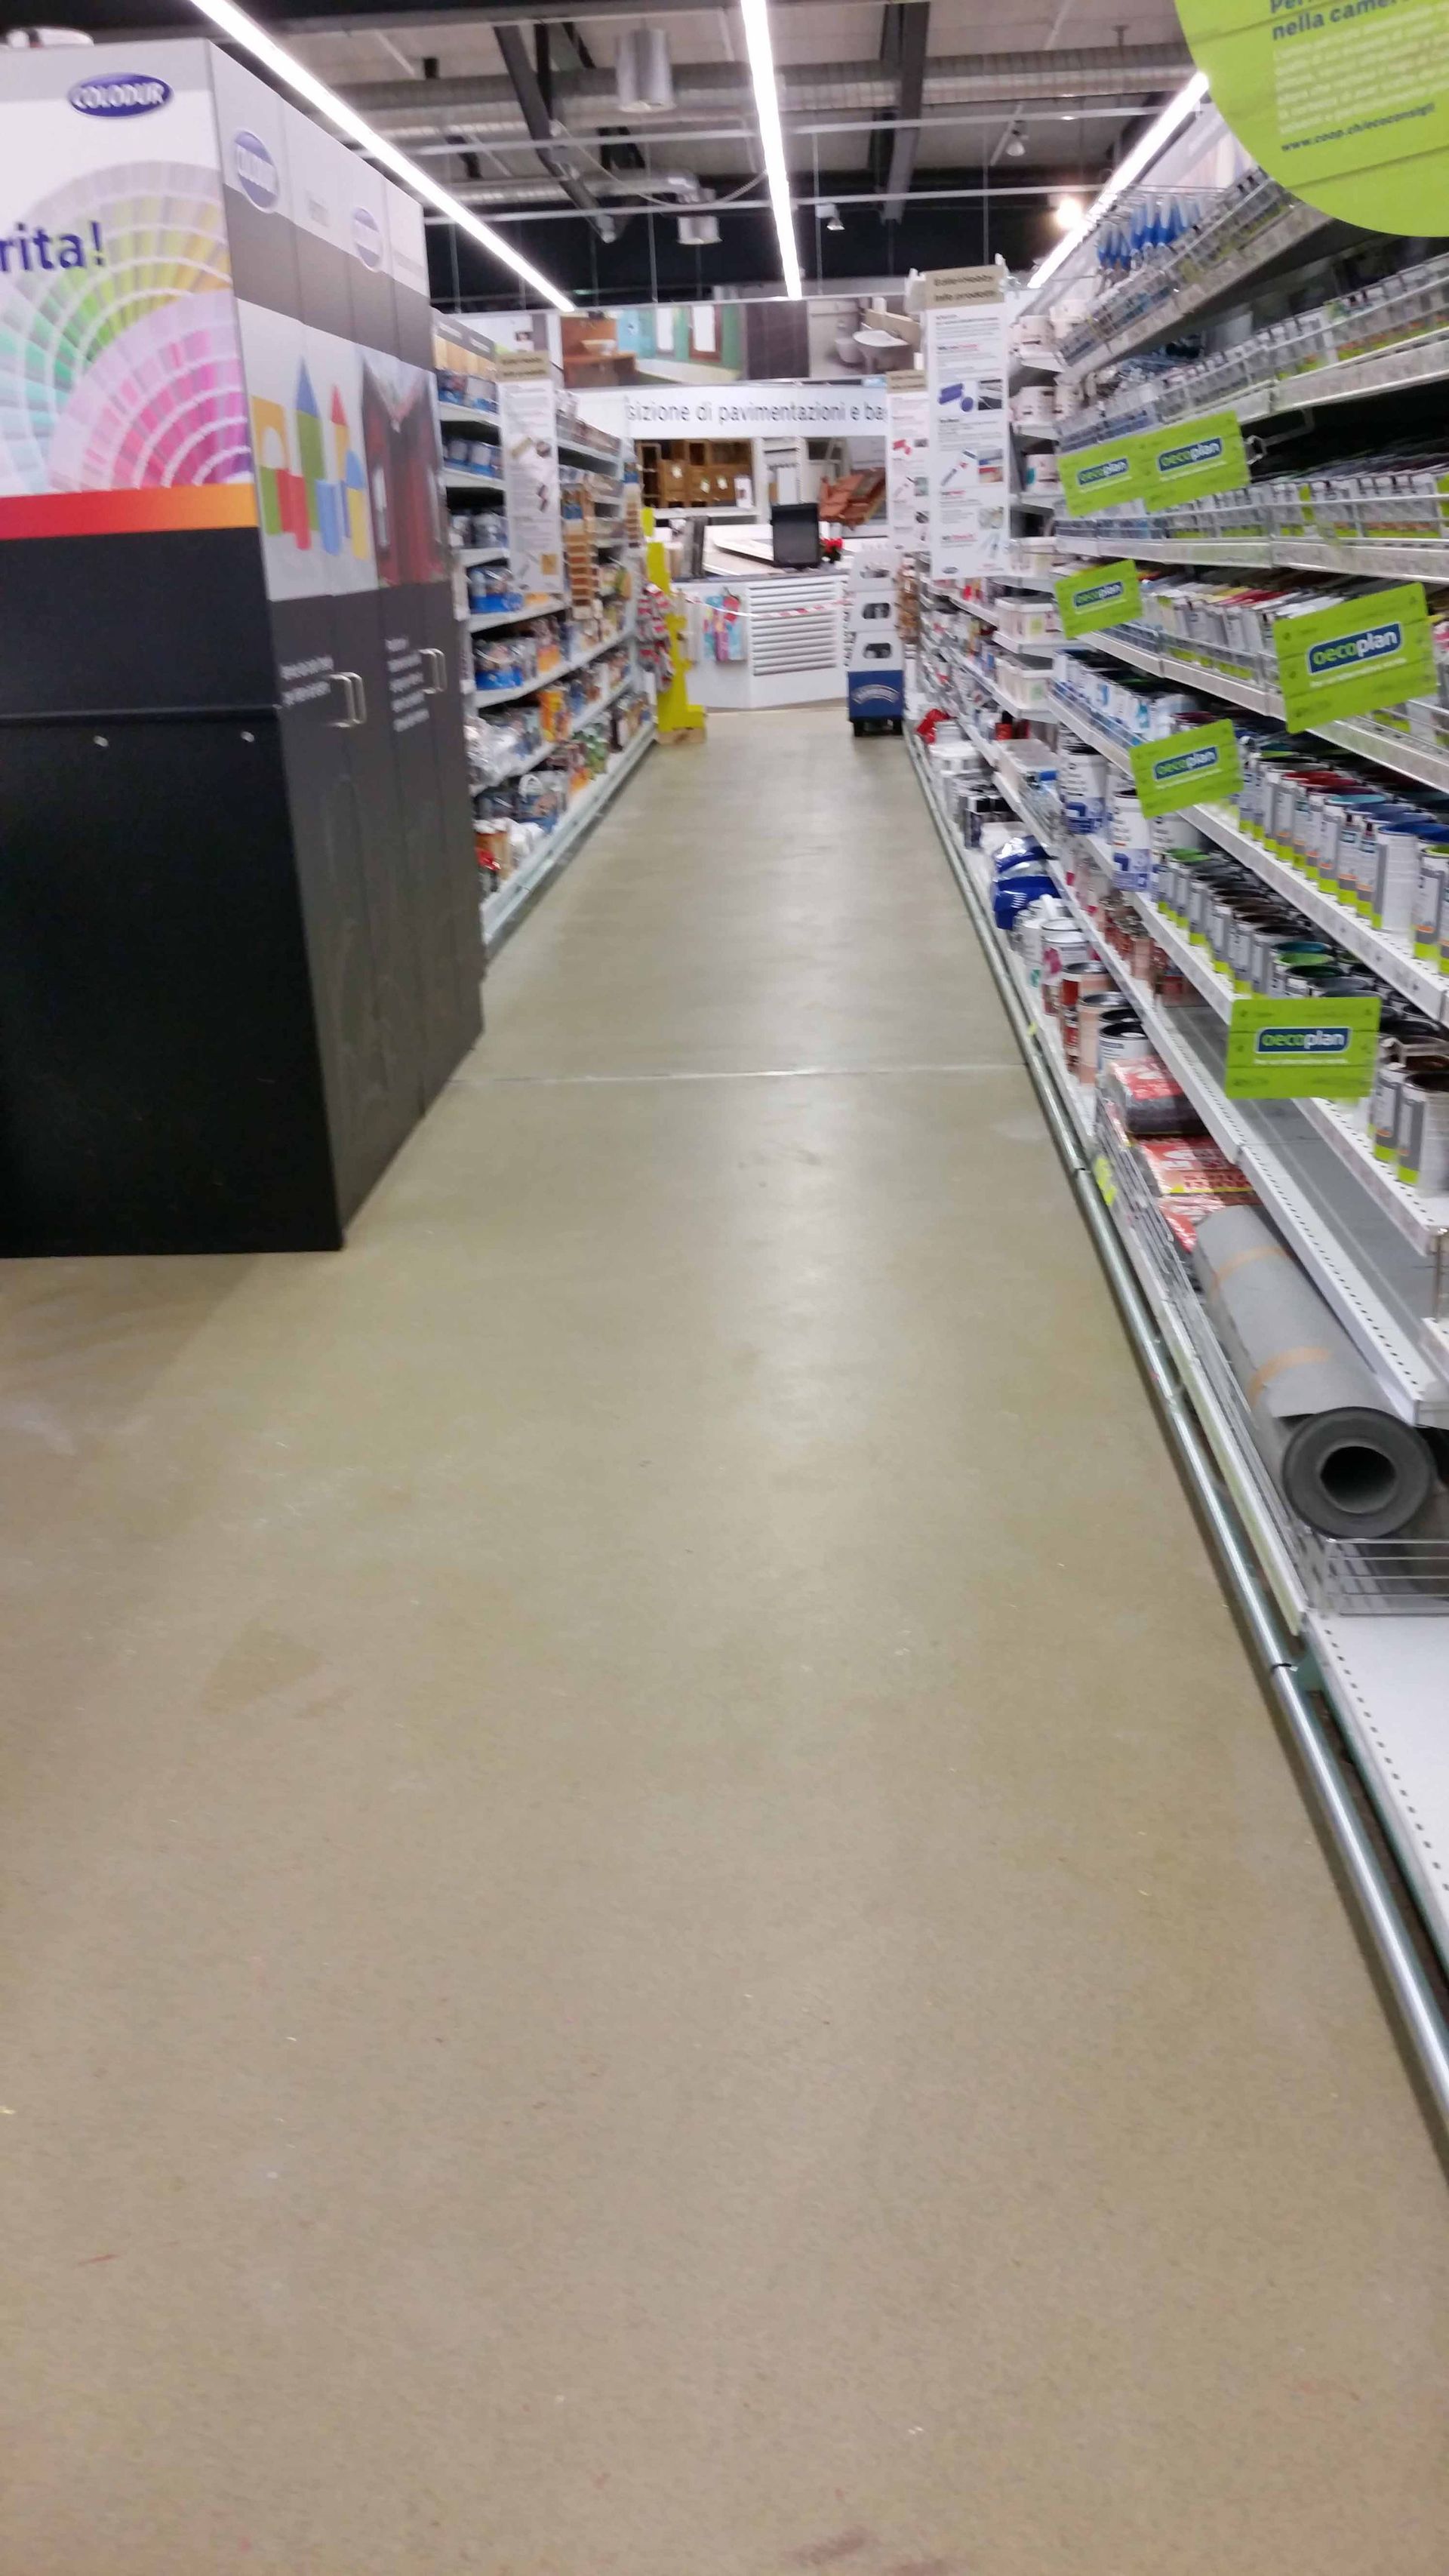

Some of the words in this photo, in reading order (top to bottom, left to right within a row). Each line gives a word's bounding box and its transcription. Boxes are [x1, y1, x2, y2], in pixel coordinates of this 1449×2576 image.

[1272, 11, 1324, 41] nella
[73, 82, 165, 109] COLODUR
[0, 220, 105, 272] rita!
[696, 401, 712, 421] di
[718, 399, 845, 426] pavimentazioni
[851, 406, 860, 421] e
[1161, 442, 1221, 467] oecoplan
[1312, 631, 1398, 665] oecoplan
[1156, 751, 1217, 776] oecoplan
[1261, 1029, 1345, 1050] oecoplan
